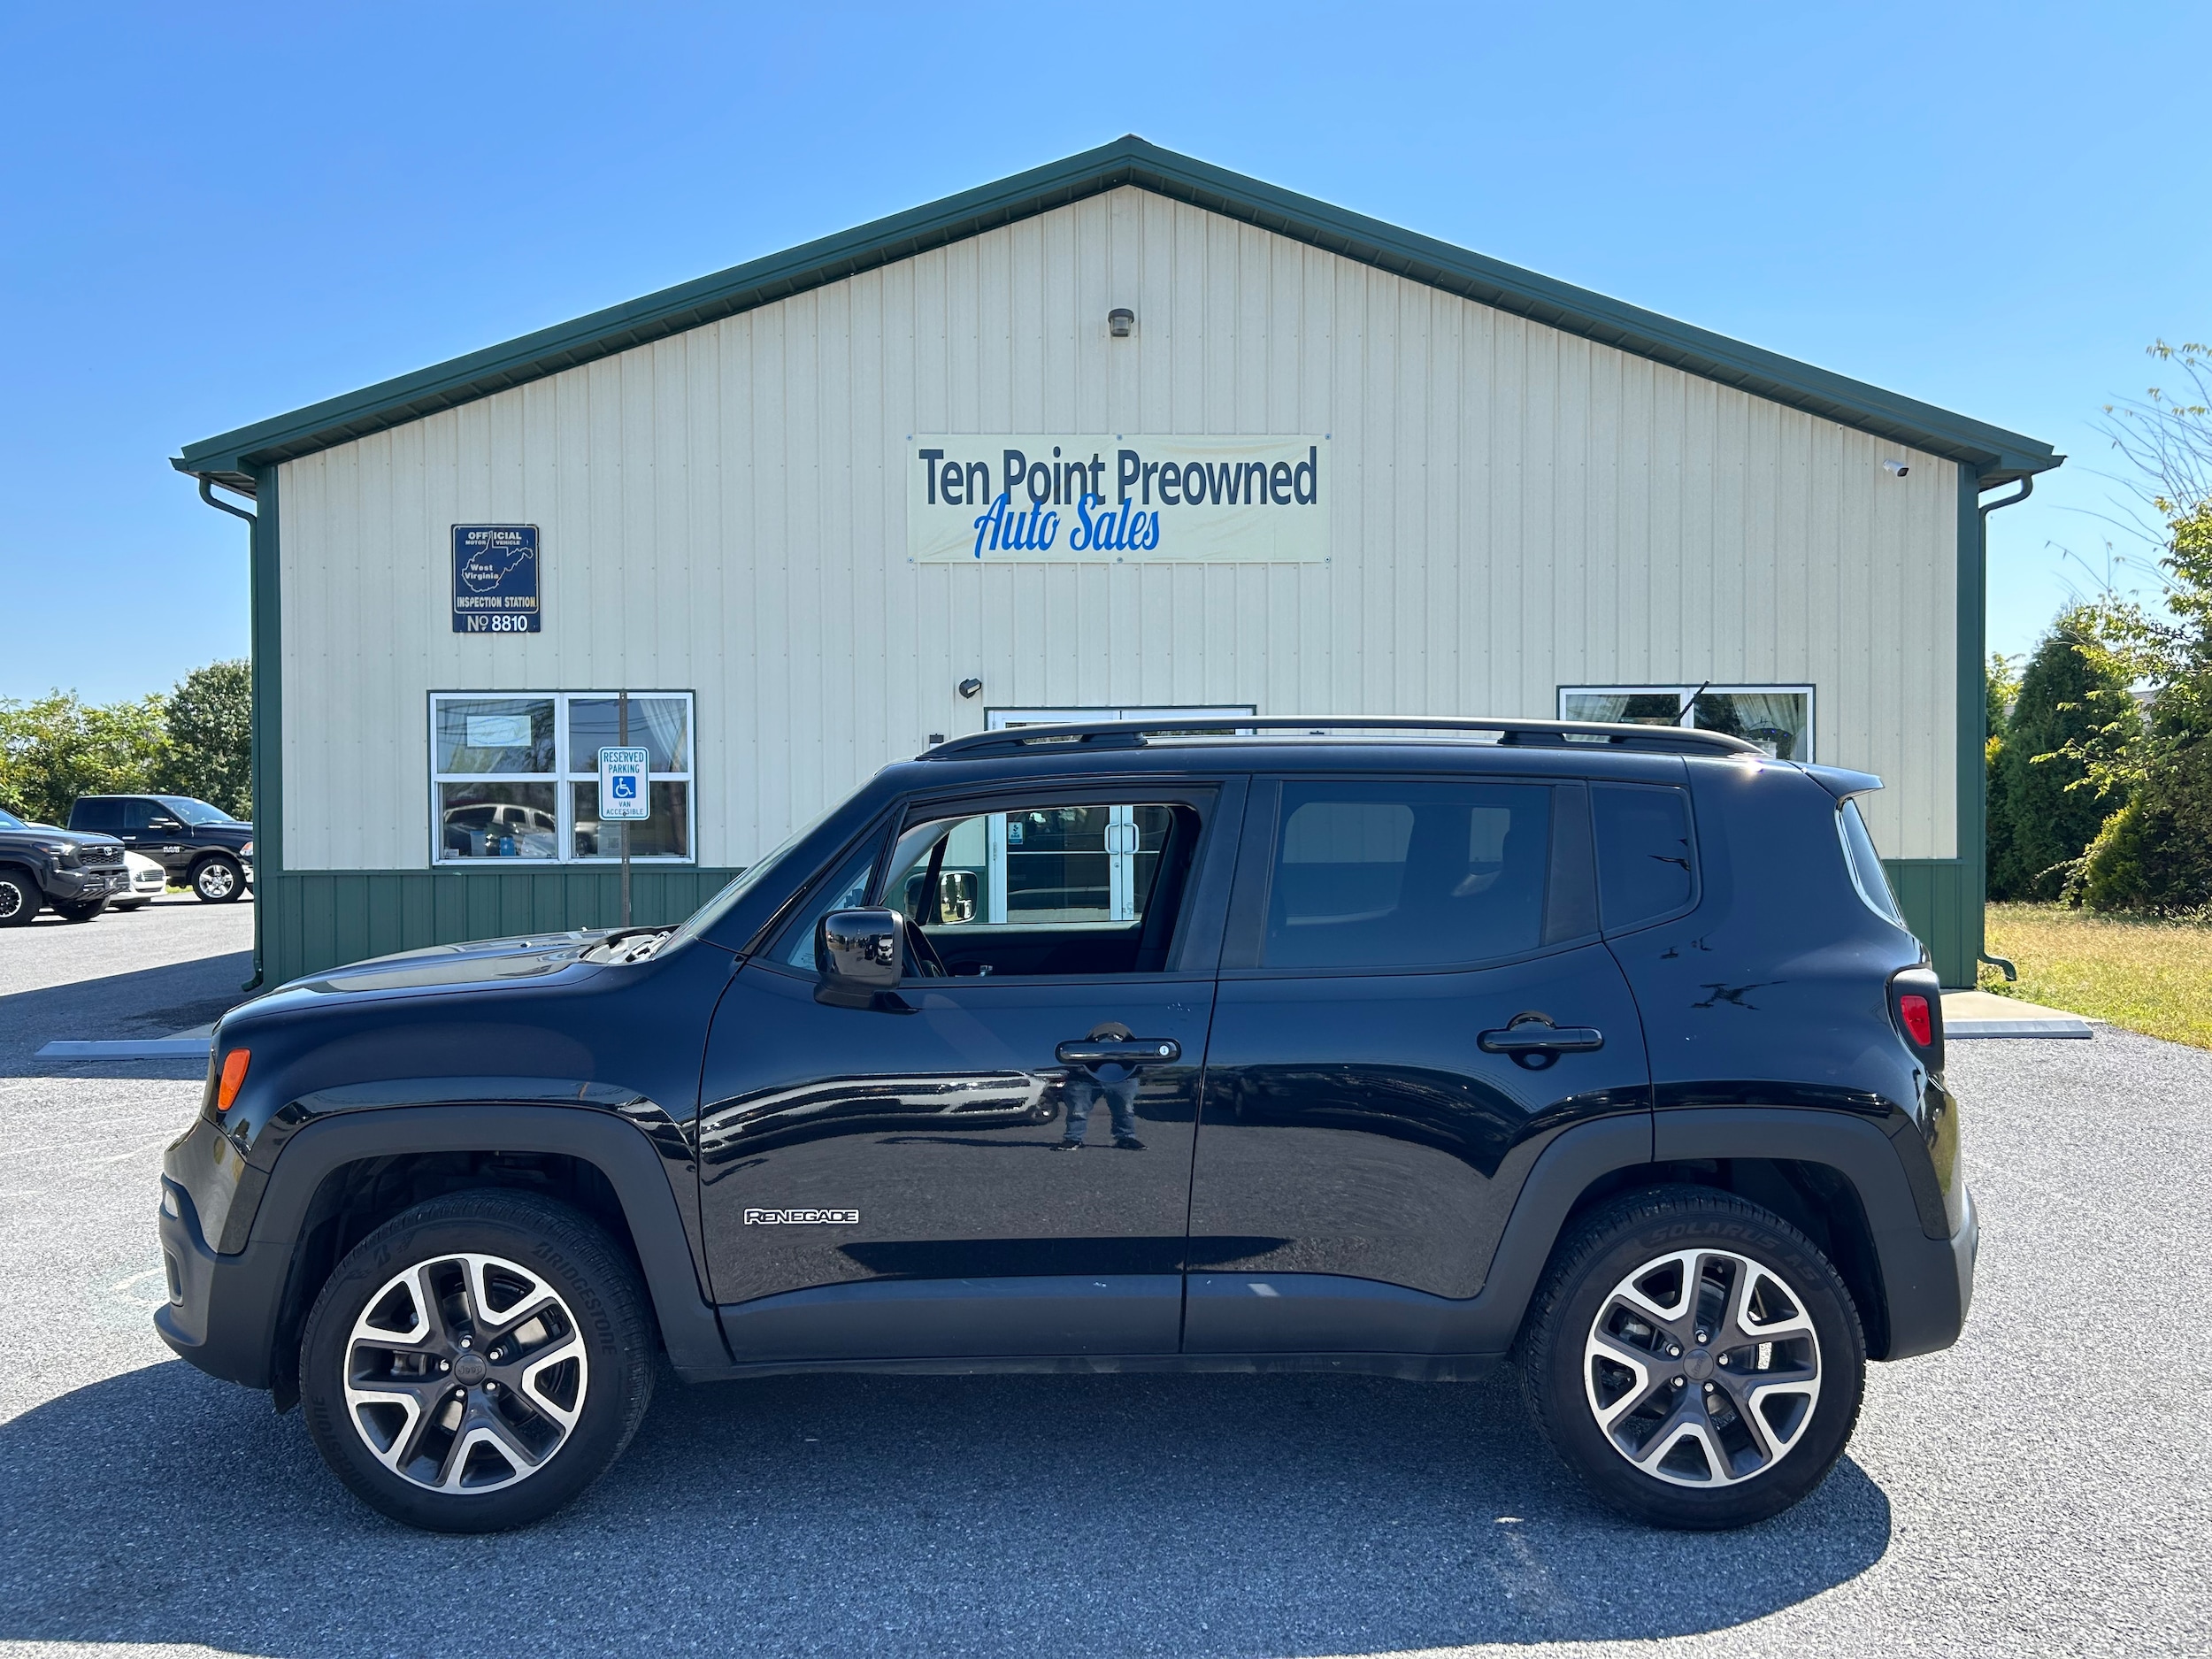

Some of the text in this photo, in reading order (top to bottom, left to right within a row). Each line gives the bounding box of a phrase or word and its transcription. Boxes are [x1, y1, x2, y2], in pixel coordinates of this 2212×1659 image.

[918, 445, 1317, 505] Ten Point Preowned
[973, 492, 1161, 559] Auto Sales
[465, 572, 499, 580] Virginia
[457, 596, 536, 608] INSPECTION STATION
[491, 615, 528, 632] 8810
[603, 751, 644, 763] RESERVED
[608, 764, 640, 774] PARKING
[744, 1208, 859, 1225] RENEGADE
[1650, 1221, 1781, 1249] SOLARUS
[531, 1241, 618, 1356] BRIDGESTONE
